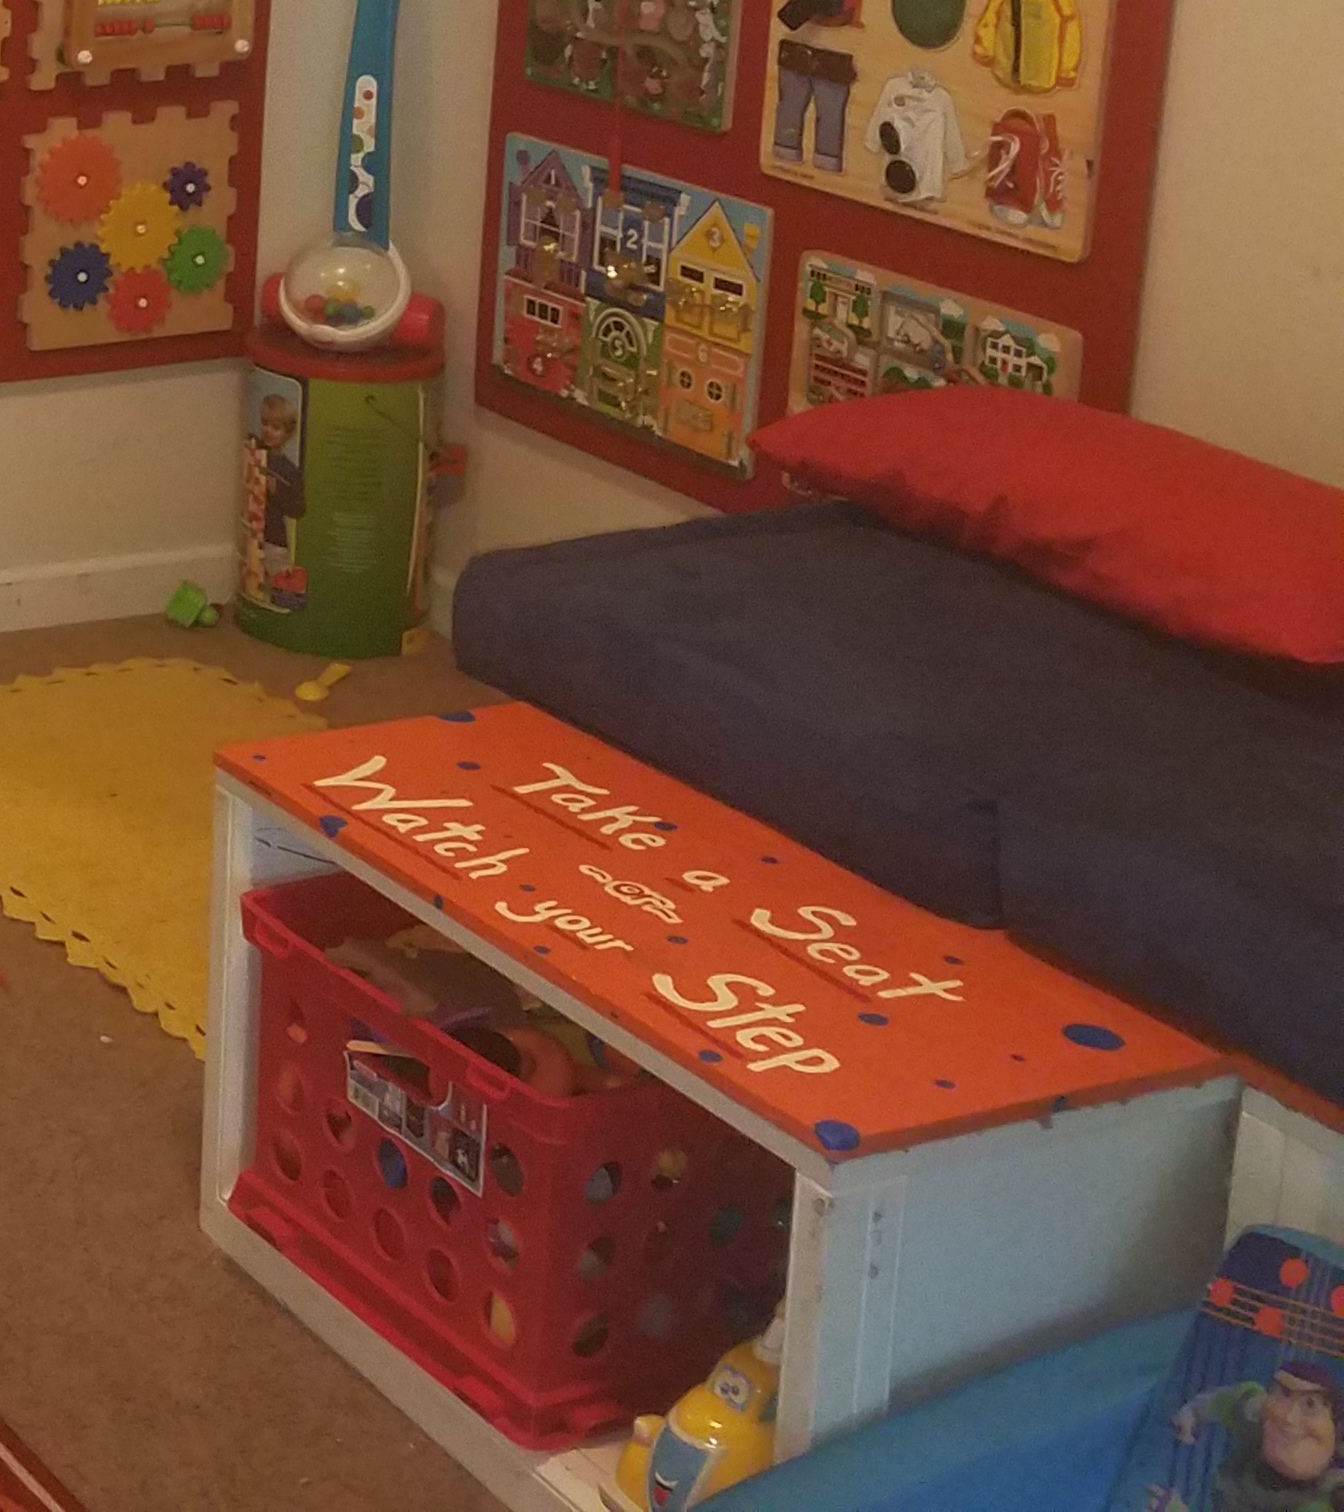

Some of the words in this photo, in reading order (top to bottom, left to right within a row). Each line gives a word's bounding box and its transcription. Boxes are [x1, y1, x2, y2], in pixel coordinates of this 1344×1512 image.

[314, 756, 509, 881] Watch
[496, 888, 634, 956] your
[652, 972, 840, 1074] Step
[513, 760, 666, 852] Take
[682, 867, 730, 893] a
[749, 904, 966, 1005] Seat
